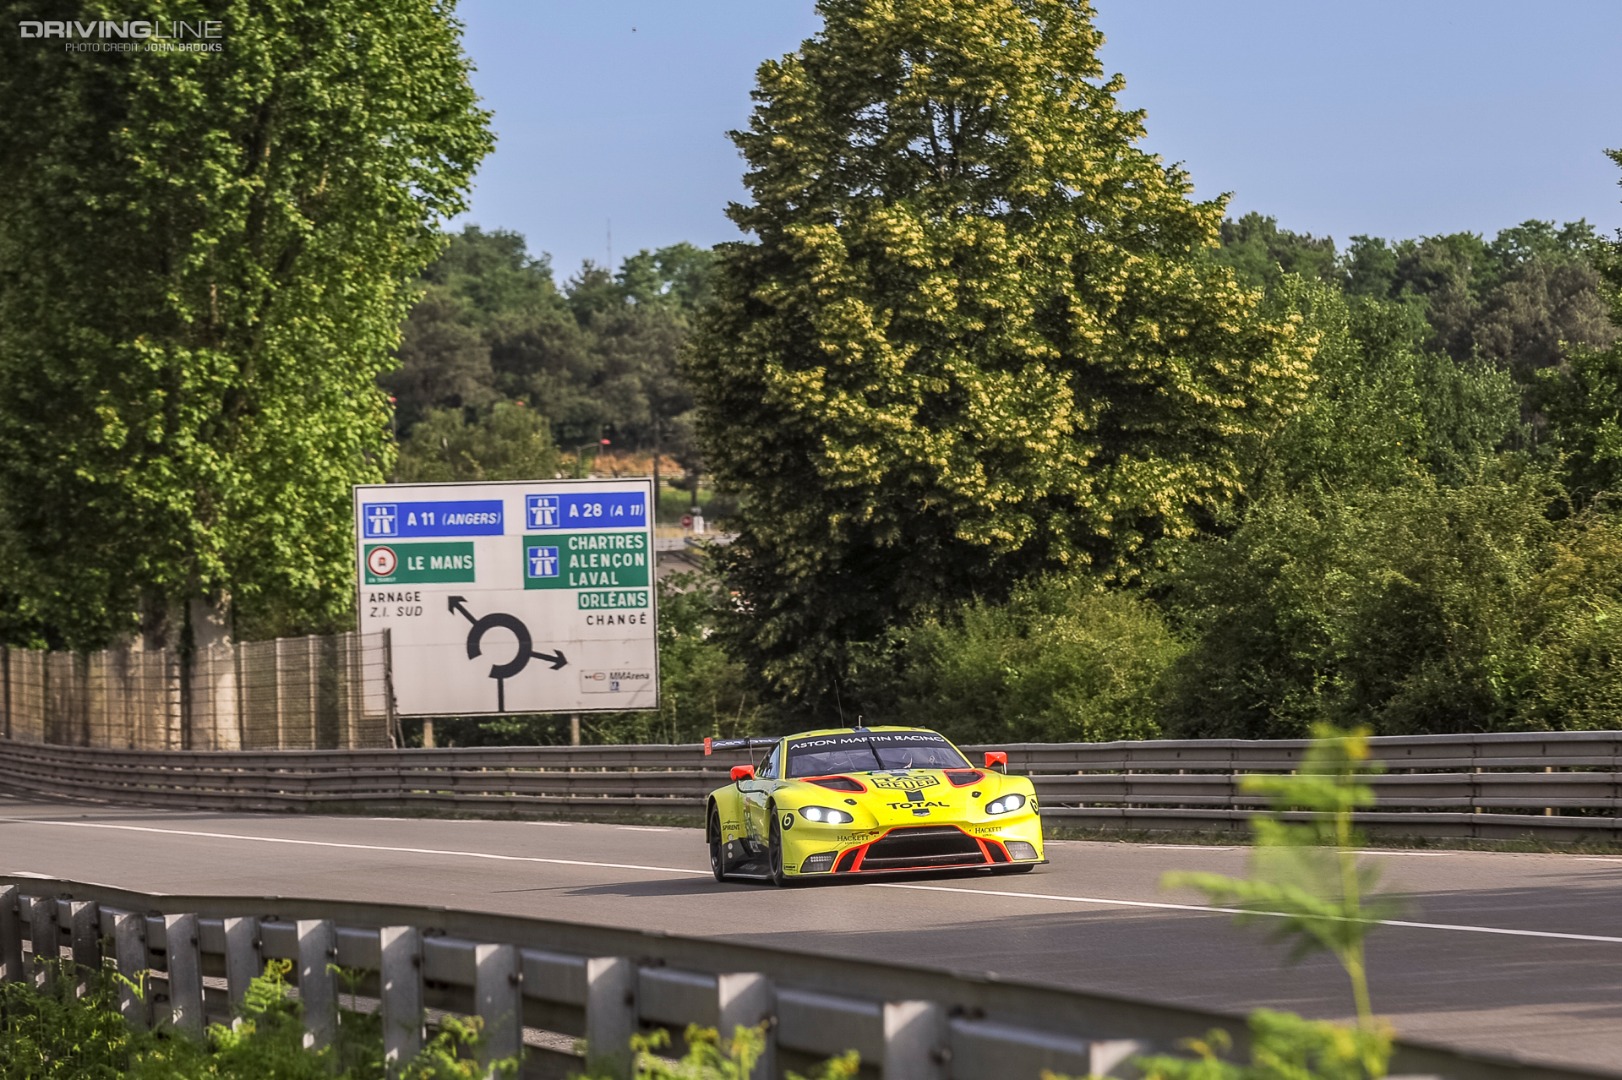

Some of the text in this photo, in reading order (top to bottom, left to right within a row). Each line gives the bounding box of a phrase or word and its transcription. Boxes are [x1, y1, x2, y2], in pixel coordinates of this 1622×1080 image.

[569, 503, 644, 518] A 28 (A 11)
[407, 512, 501, 526] A 11 (ANGERS)
[568, 535, 644, 550] CHARTRES
[407, 555, 473, 571] LE MANS
[569, 553, 645, 568] ALENÇON
[569, 572, 619, 586] LAVAL
[369, 591, 422, 603] ARNAGE
[580, 591, 647, 608] ORLÉANS
[370, 605, 423, 618] Z.I. SUD
[586, 612, 647, 625] CHANGÉ
[790, 738, 837, 750] ASTON
[840, 735, 891, 744] MARTIN
[886, 801, 950, 810] TOTAL
[975, 826, 1002, 834] HACKETT
[837, 834, 869, 842] HACKETT
